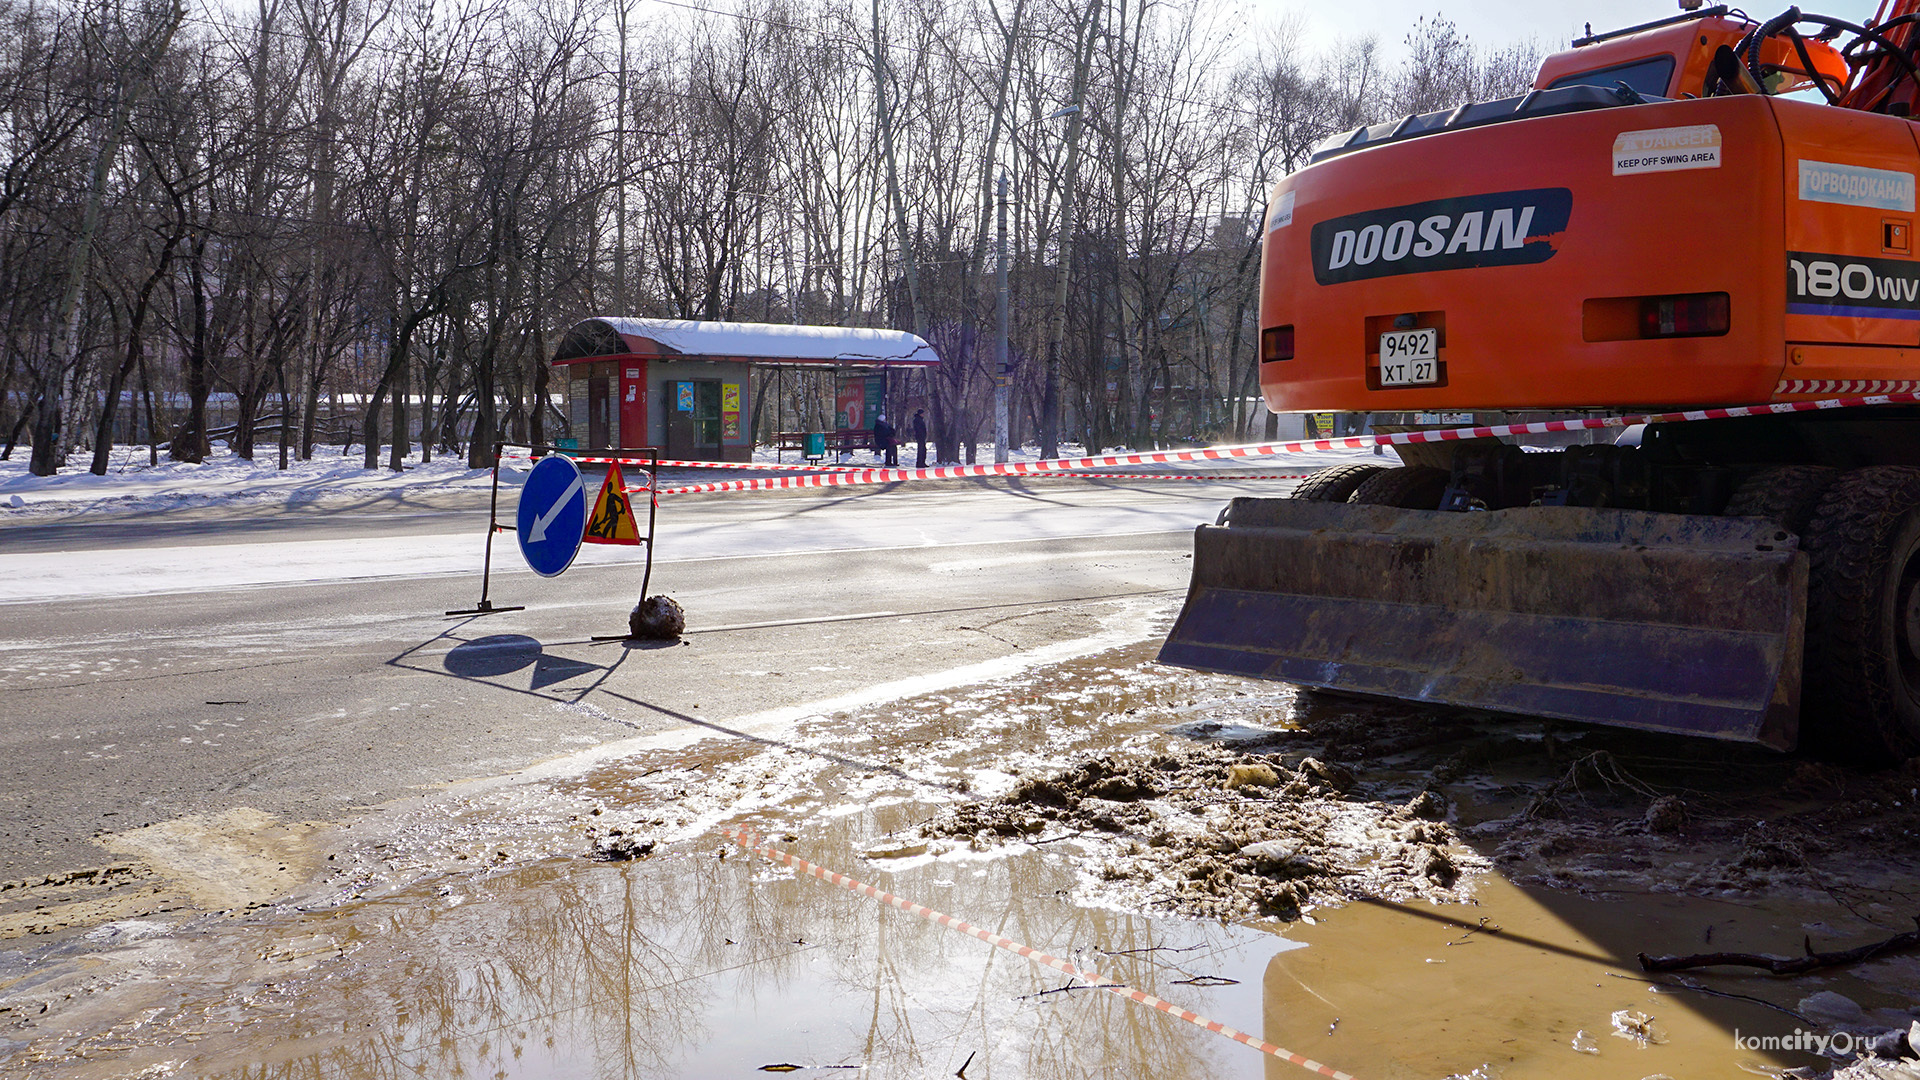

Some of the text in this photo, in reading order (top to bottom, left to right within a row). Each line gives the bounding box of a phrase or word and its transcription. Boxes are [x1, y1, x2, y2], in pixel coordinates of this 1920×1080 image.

[1642, 129, 1713, 149] DANGER
[1617, 152, 1716, 168] KEEP OFF SWING AREA
[1801, 169, 1914, 201] ГОРВОДОКАНАЛ
[1328, 206, 1536, 270] DOOSAN
[1386, 333, 1429, 357] 9492
[1415, 362, 1432, 380] 27
